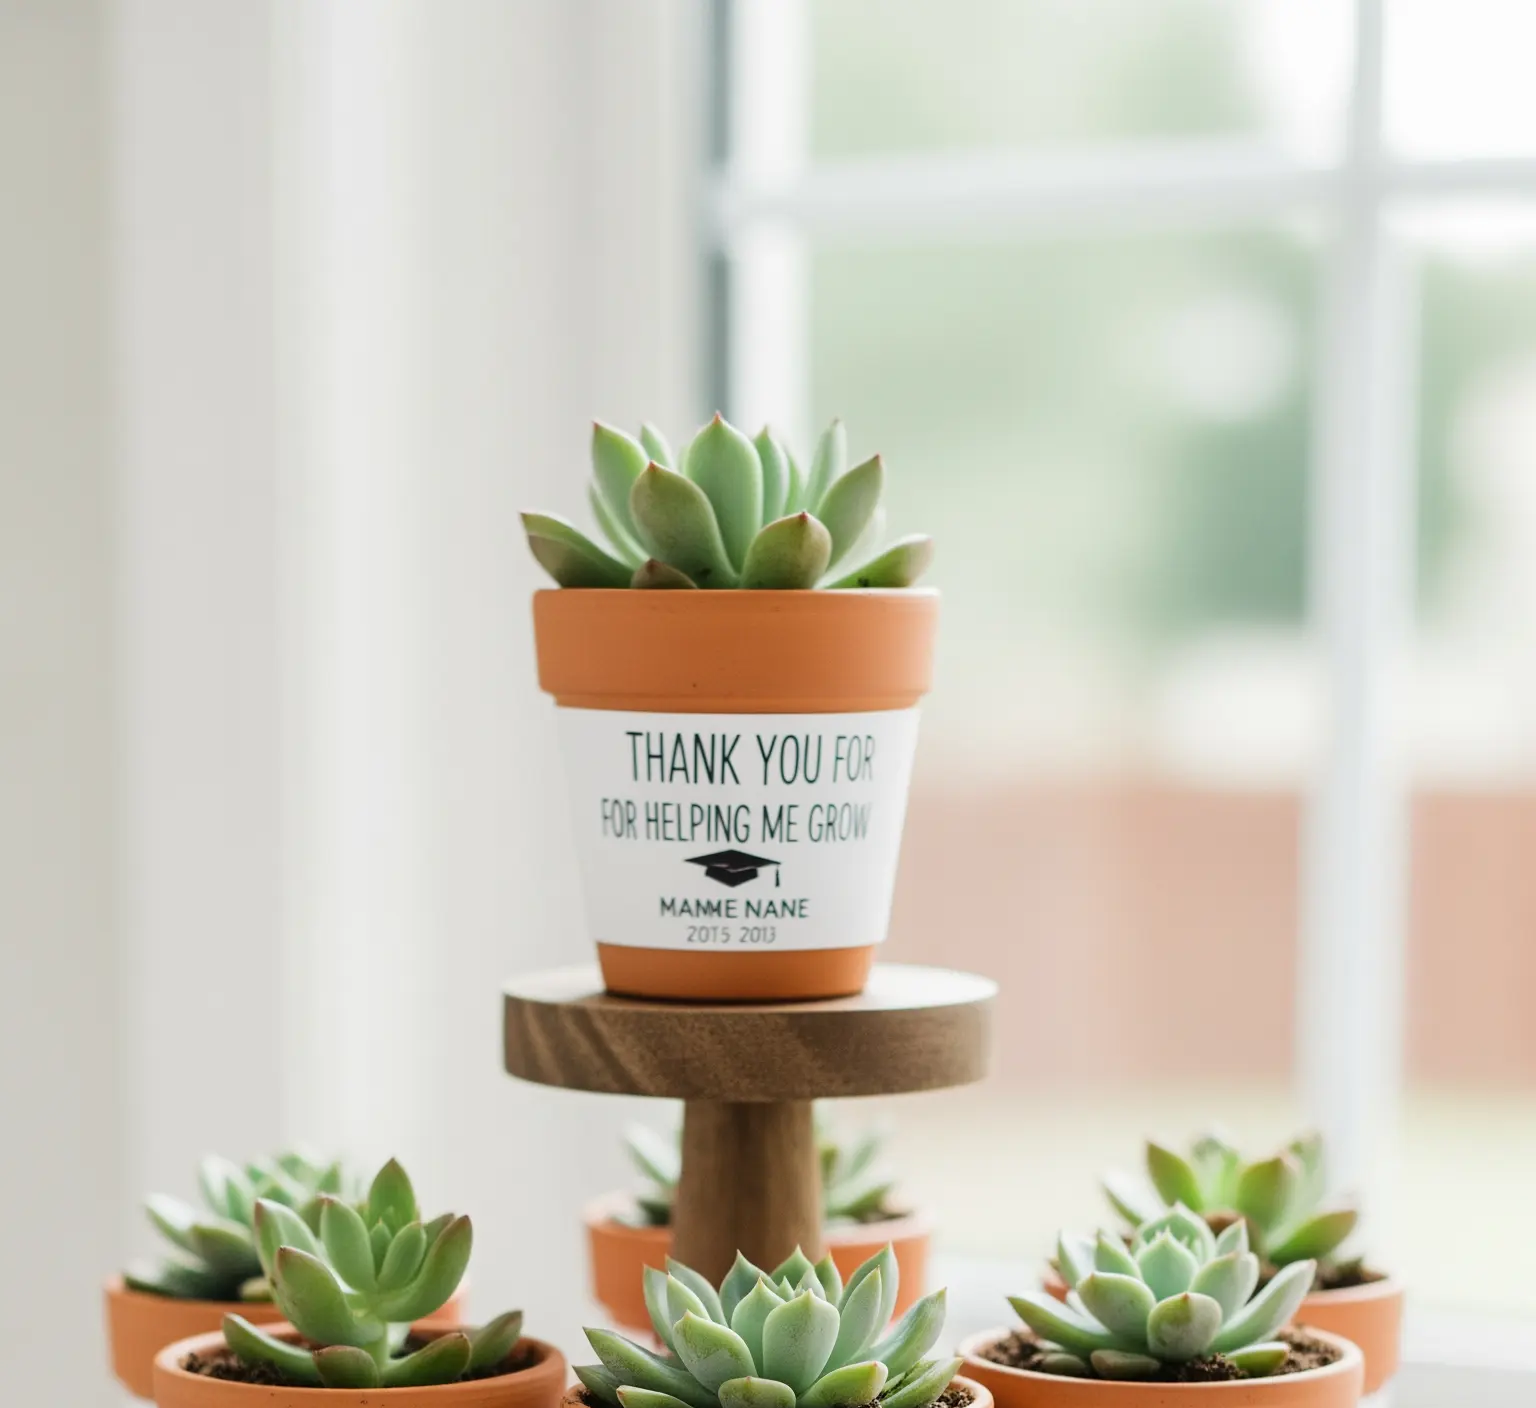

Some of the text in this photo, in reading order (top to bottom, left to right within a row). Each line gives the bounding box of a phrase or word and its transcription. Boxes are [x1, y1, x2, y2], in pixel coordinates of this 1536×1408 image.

[626, 731, 875, 785] THANK YOU FOR
[601, 798, 872, 843] FOR HELPING ME GROW
[745, 898, 809, 918] NANE
[687, 926, 731, 943] 2015
